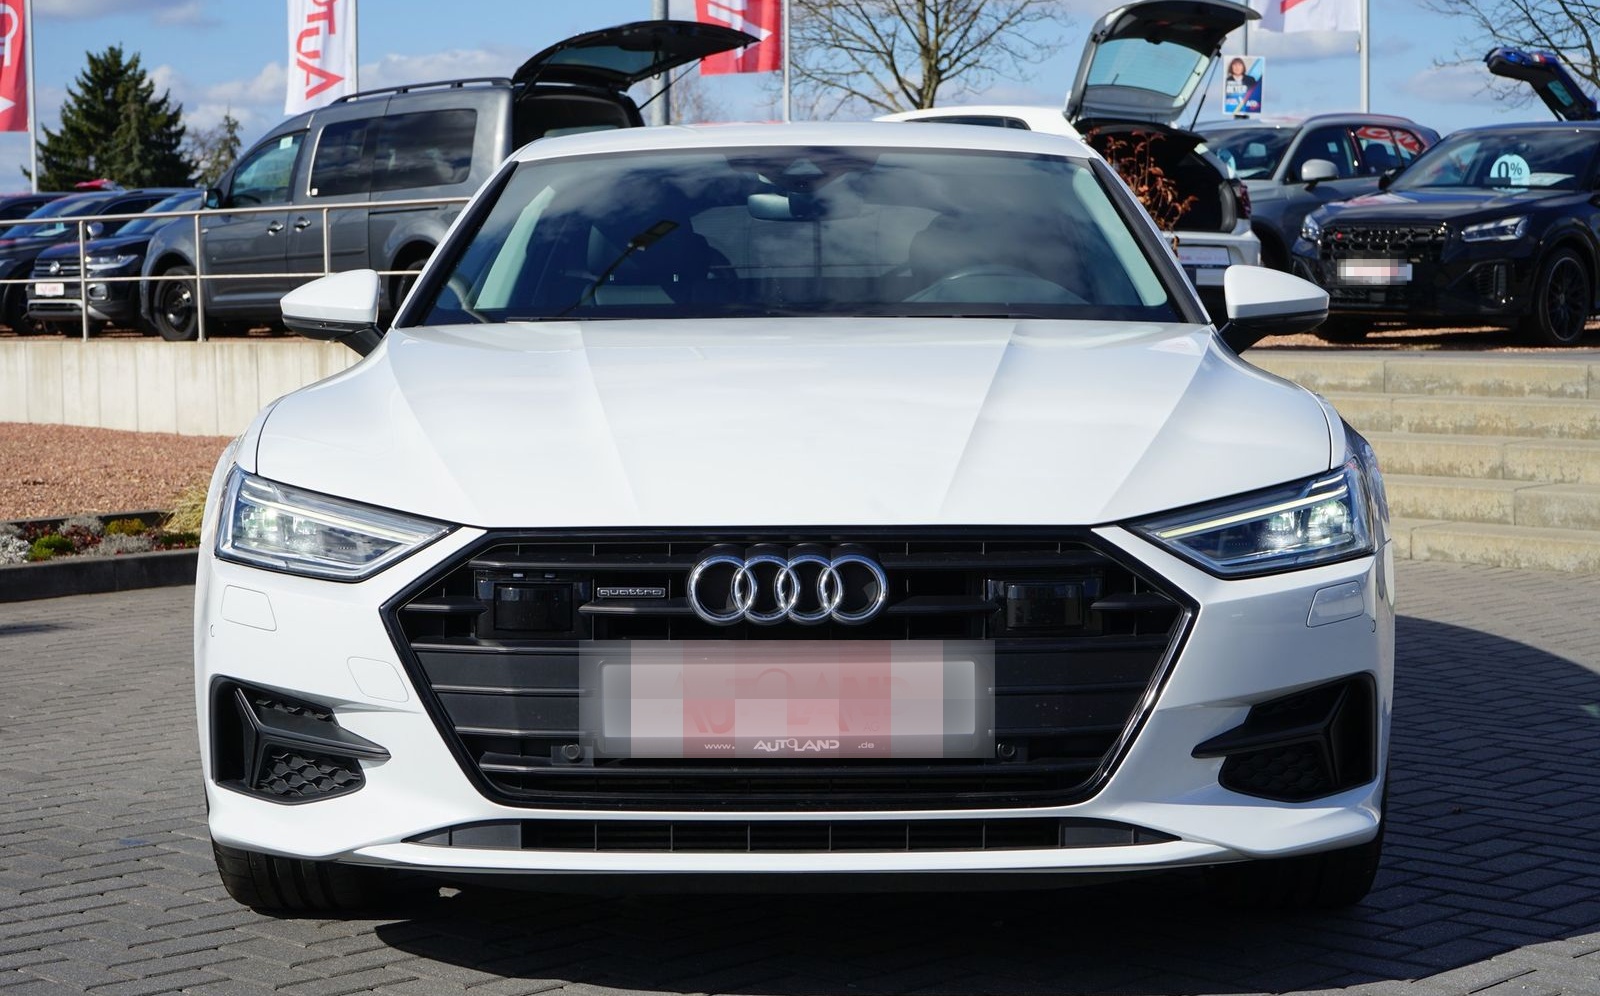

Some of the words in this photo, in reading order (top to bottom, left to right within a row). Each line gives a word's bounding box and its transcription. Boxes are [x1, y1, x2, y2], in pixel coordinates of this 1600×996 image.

[600, 588, 662, 597] quattro
[704, 742, 735, 750] www.
[753, 737, 840, 752] AUTOLAND
[857, 741, 875, 749] .de
